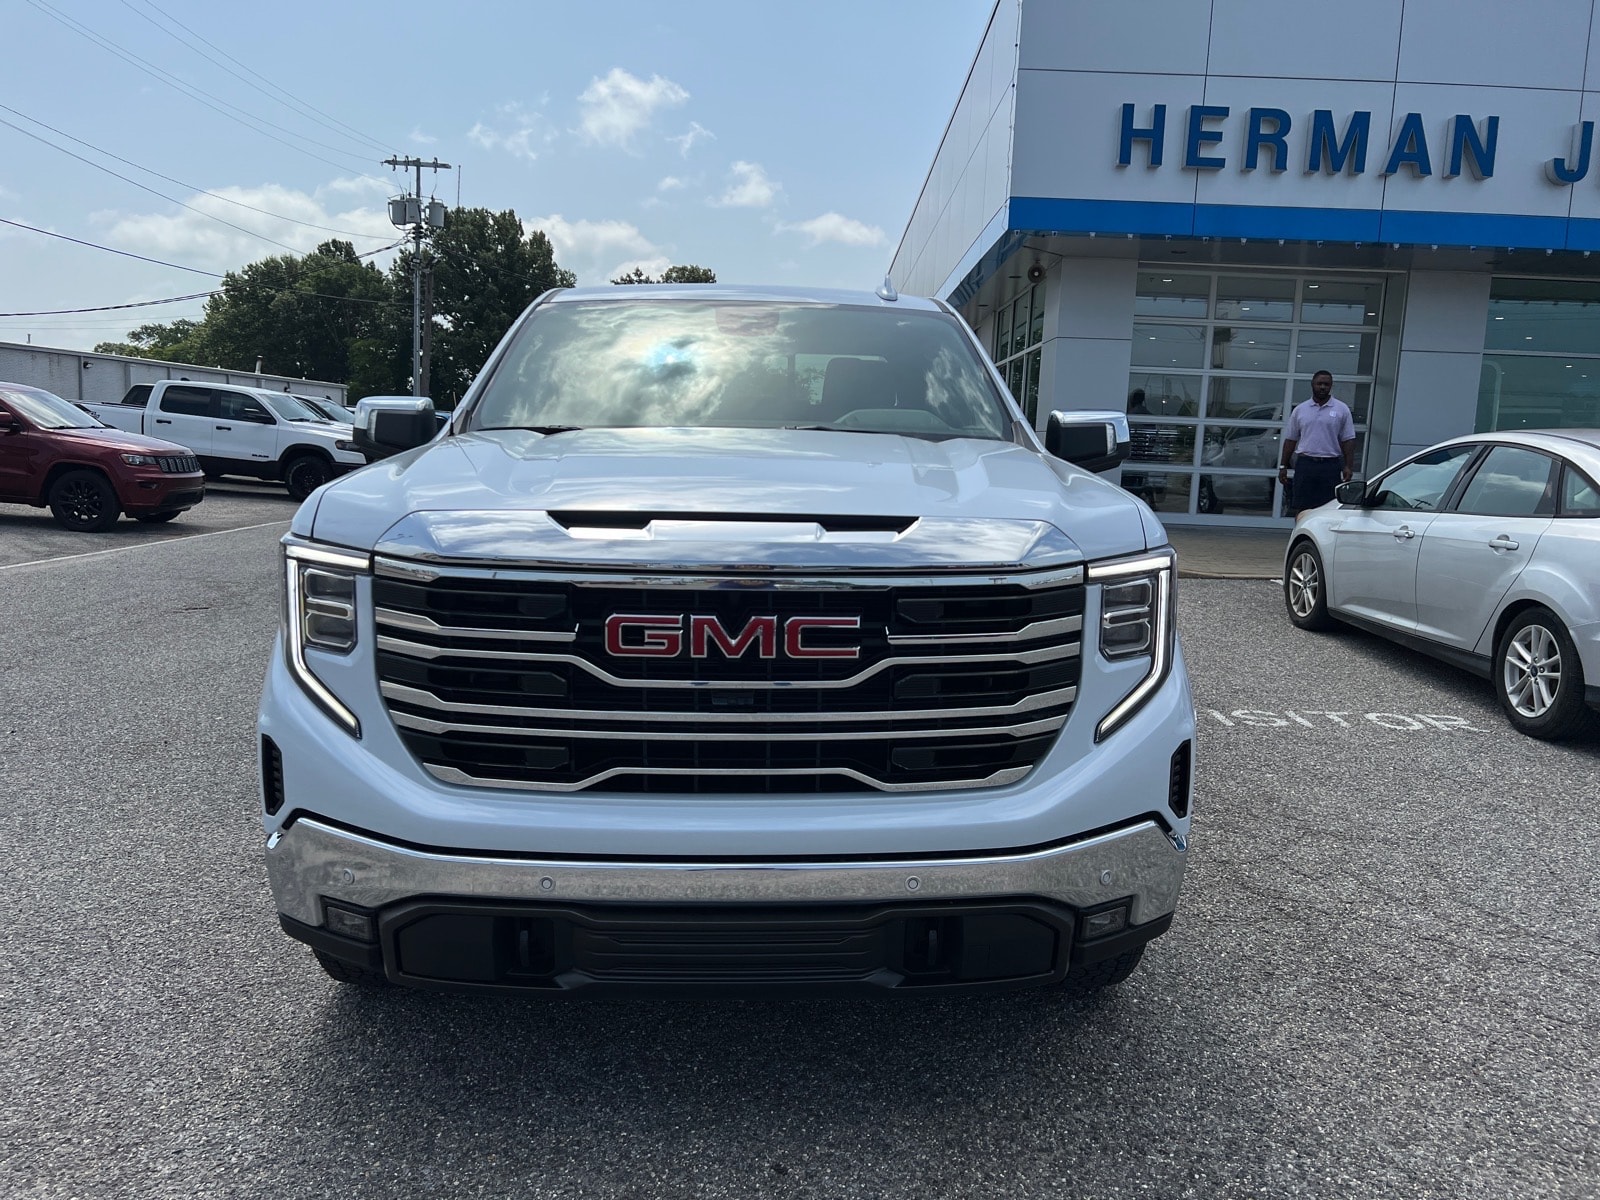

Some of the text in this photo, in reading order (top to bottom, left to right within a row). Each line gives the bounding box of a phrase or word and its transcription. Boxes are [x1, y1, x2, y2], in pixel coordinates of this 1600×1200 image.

[1116, 102, 1499, 180] HERMAN
[604, 612, 861, 659] GMC
[1208, 709, 1491, 733] ISITOR
